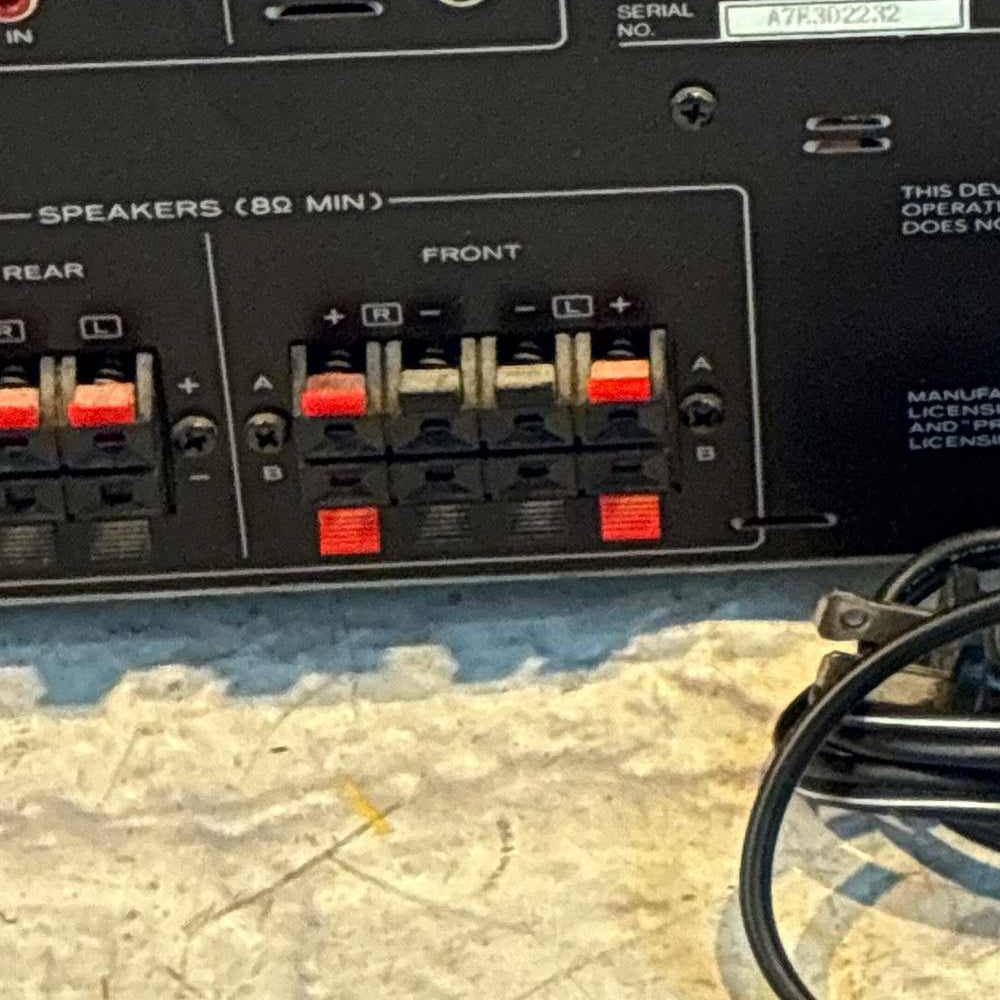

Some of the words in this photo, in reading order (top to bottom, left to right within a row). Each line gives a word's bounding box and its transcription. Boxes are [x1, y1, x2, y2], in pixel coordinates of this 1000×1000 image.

[617, 3, 694, 20] SERIAL
[6, 29, 34, 45] IN
[617, 21, 654, 38] NO.
[900, 184, 952, 200] THIS
[38, 199, 223, 224] SPEAKERS
[305, 192, 384, 212] MIN)
[901, 218, 968, 236] DOES
[423, 243, 521, 263] FRONT
[2, 262, 85, 281] REAR
[373, 308, 391, 322] R
[563, 300, 579, 314] L
[93, 318, 109, 334] L
[692, 355, 713, 371] A
[254, 374, 273, 390] A
[908, 420, 958, 434] AND
[696, 445, 715, 461] B
[263, 465, 283, 481] B
